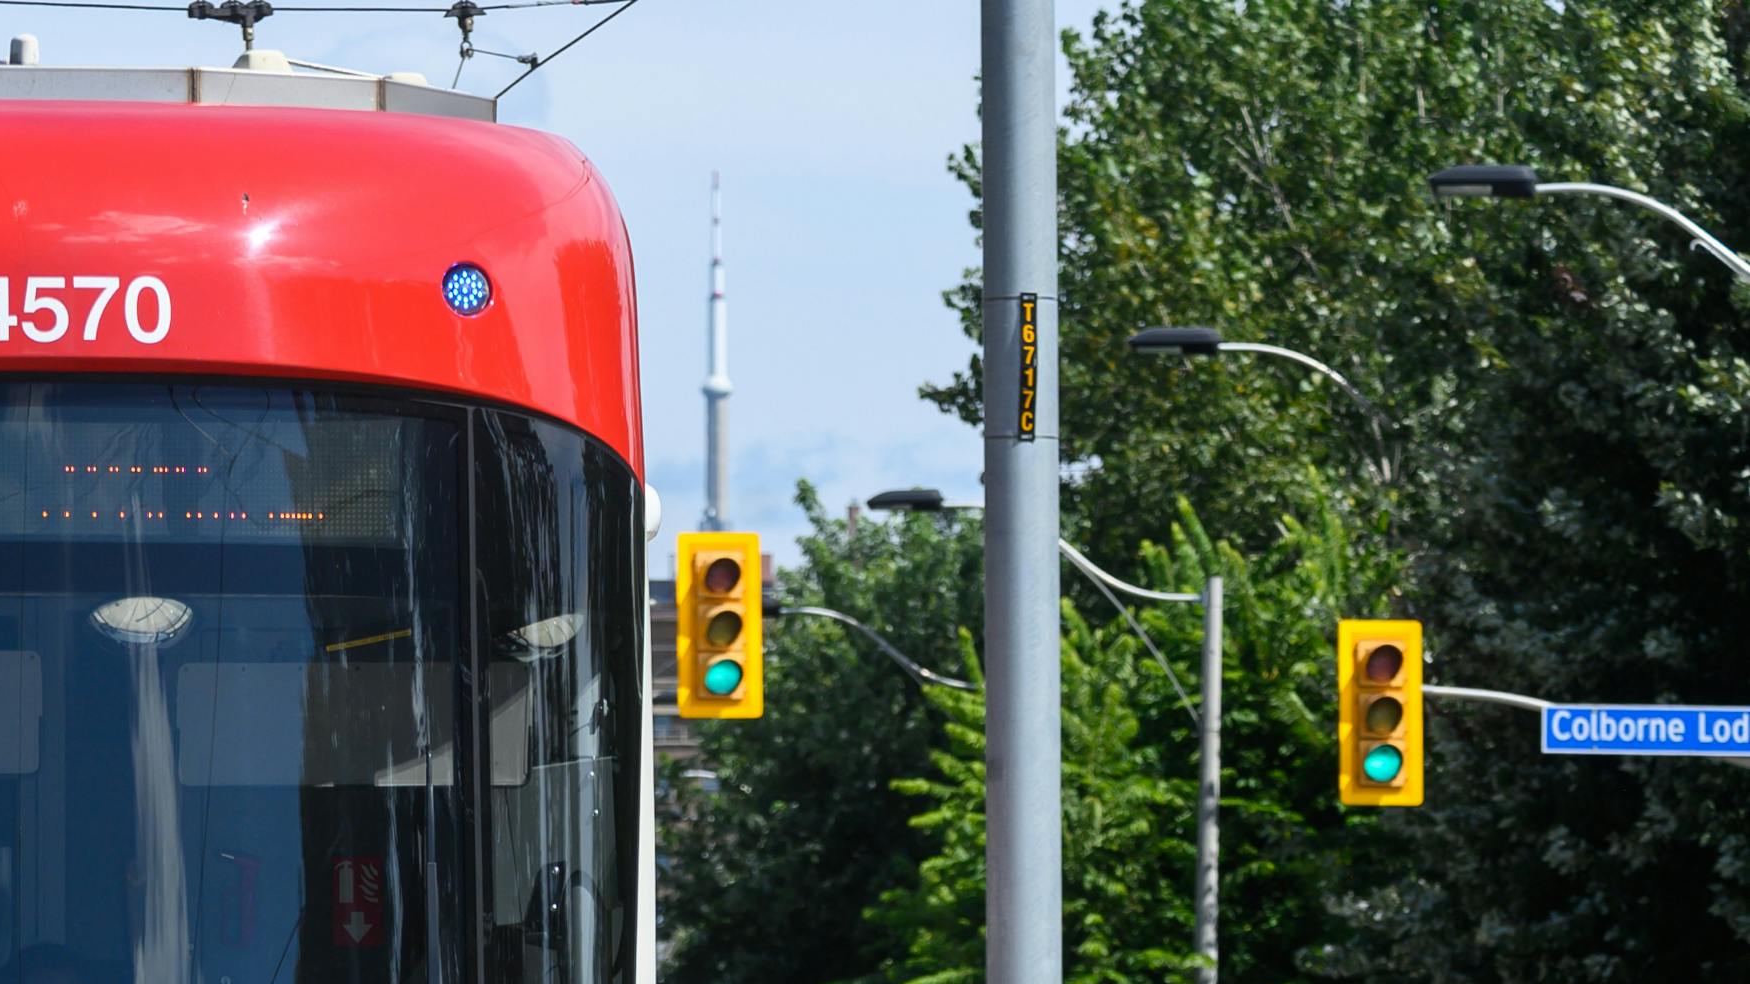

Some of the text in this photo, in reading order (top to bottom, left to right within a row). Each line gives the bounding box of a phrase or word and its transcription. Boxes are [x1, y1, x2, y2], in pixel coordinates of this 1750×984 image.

[1020, 302, 1036, 432] T6717C
[1551, 709, 1749, 744] Colborne Lod
